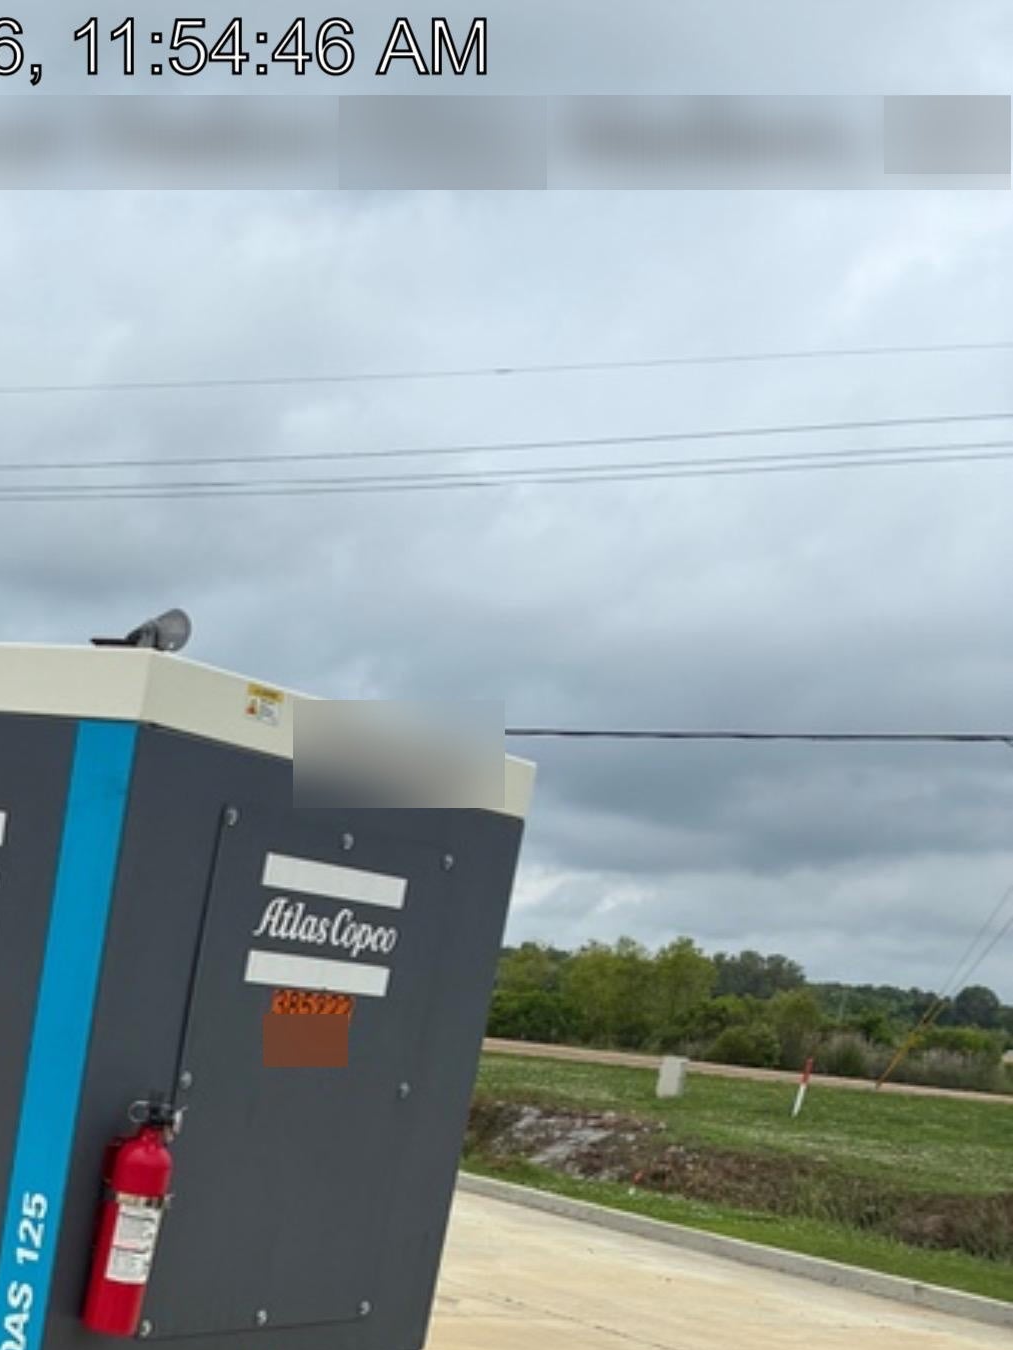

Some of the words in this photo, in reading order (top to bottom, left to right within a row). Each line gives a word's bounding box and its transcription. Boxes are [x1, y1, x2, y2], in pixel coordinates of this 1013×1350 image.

[252, 896, 331, 945] Atlas
[331, 908, 399, 958] Copco
[16, 1192, 49, 1265] 125
